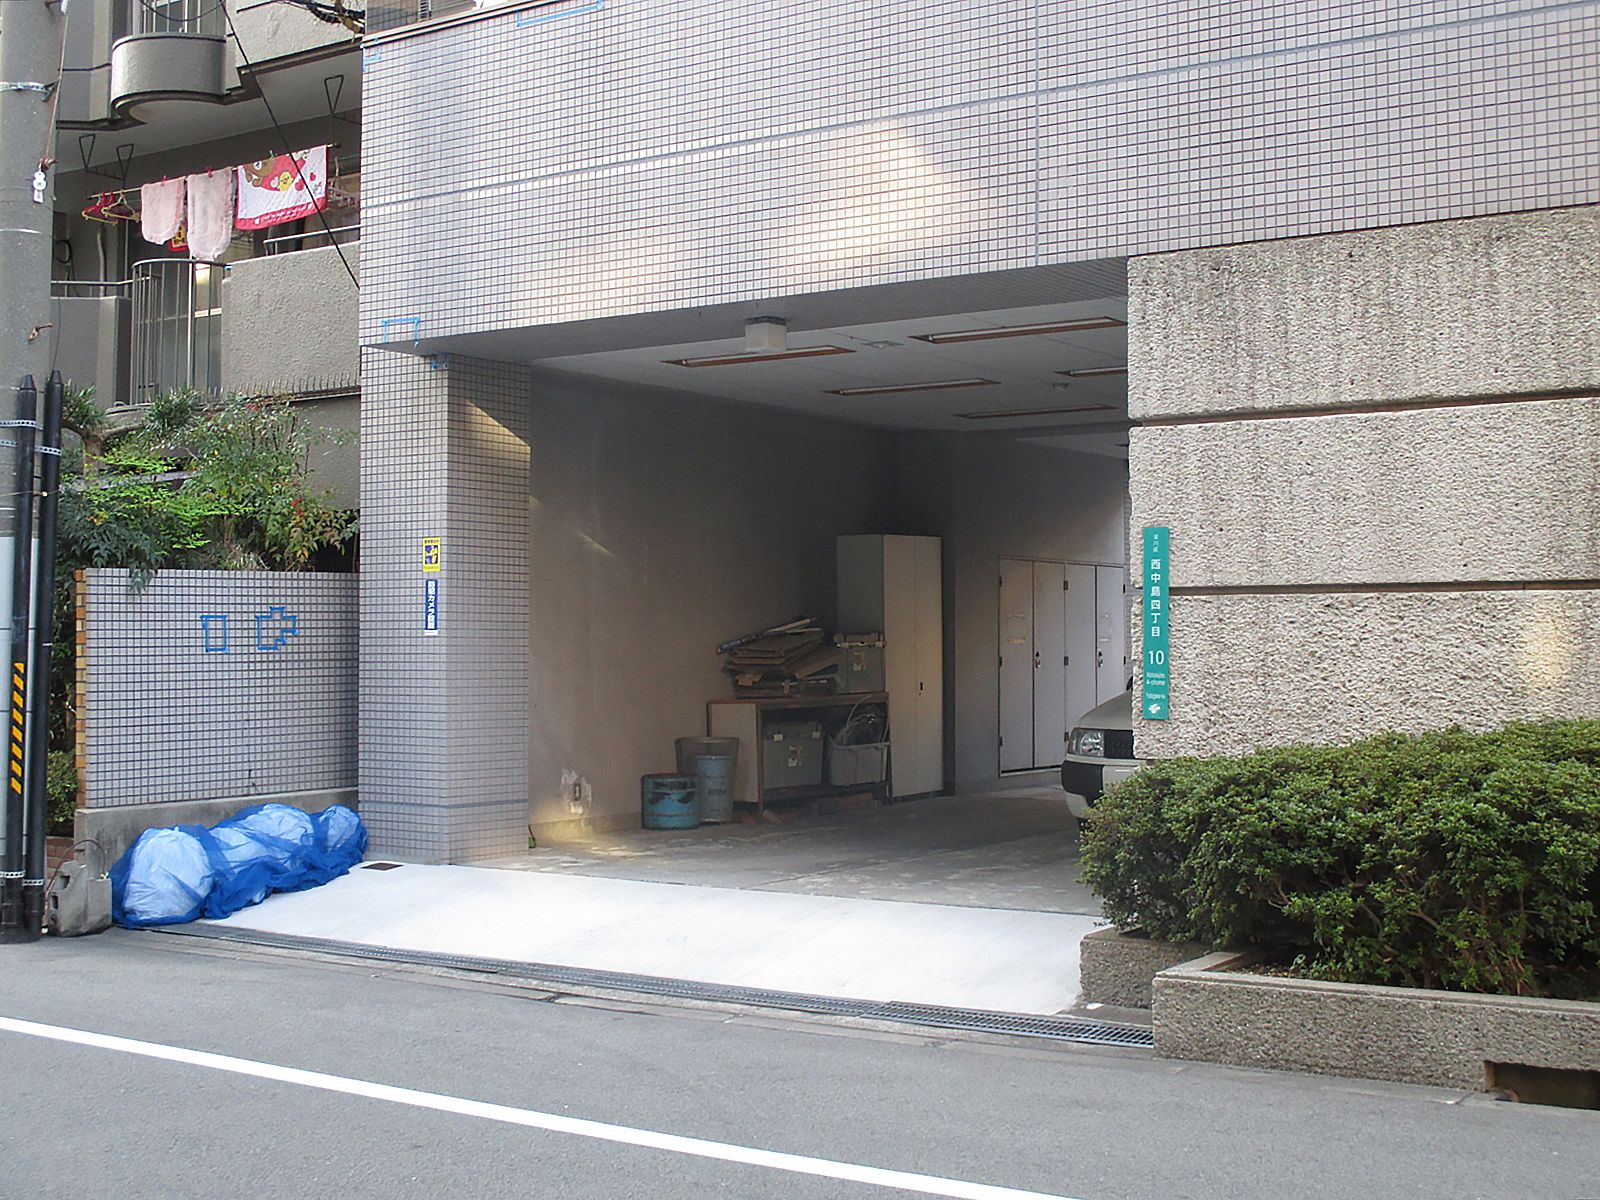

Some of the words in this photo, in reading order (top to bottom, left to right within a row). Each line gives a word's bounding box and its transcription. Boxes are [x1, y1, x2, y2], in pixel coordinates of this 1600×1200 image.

[1150, 559, 1161, 637] 西中島四丁目
[1148, 650, 1164, 665] 10
